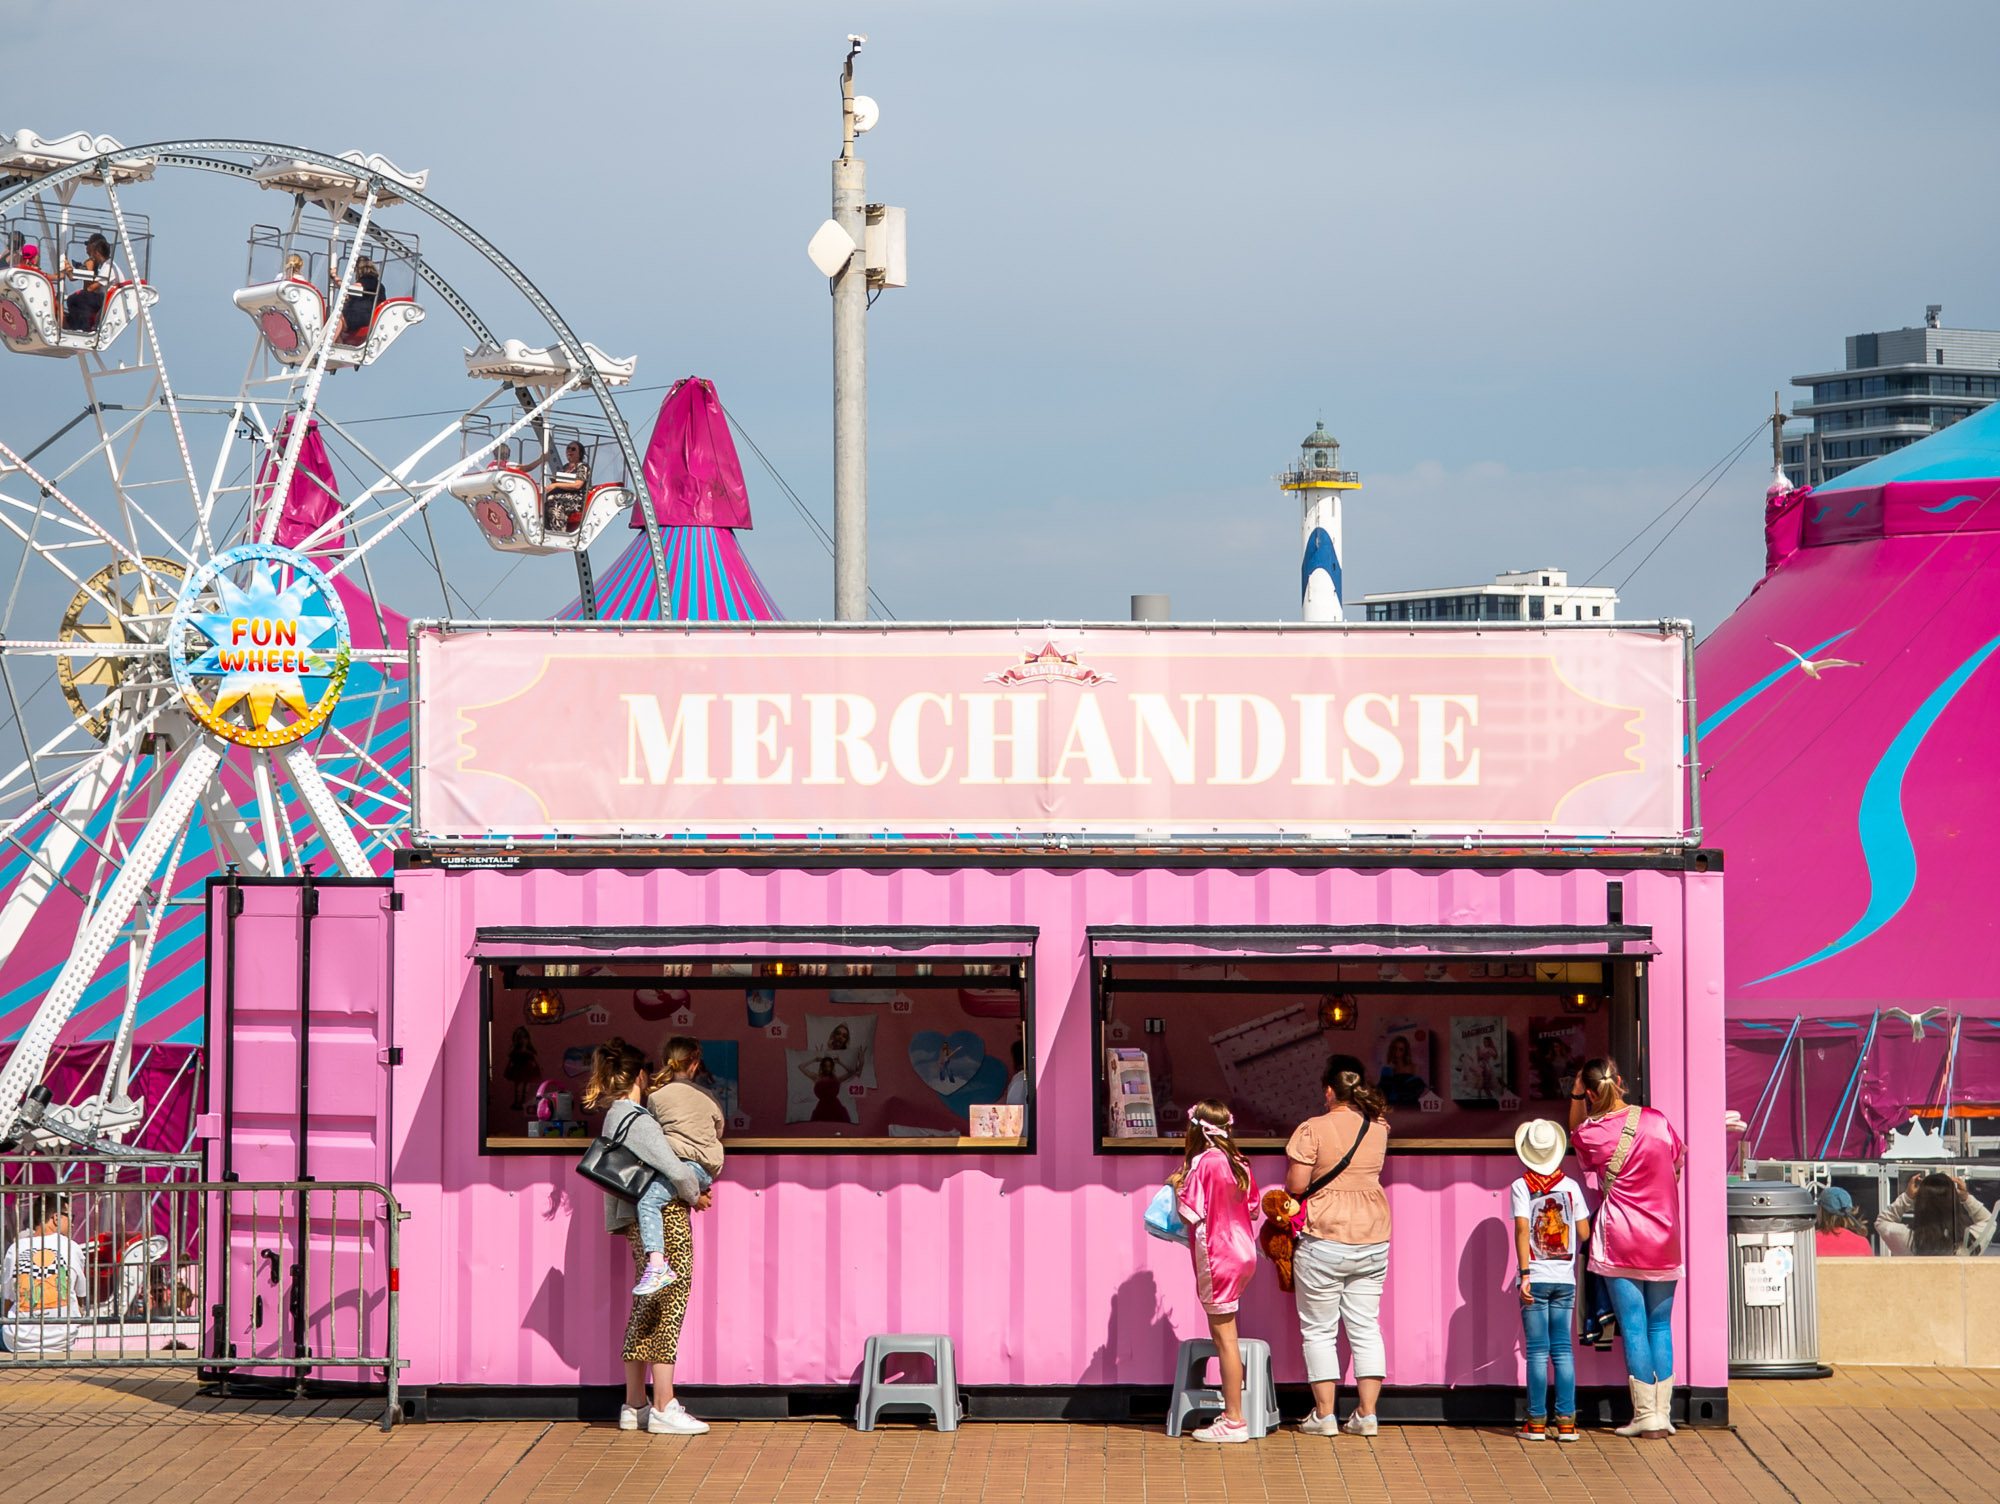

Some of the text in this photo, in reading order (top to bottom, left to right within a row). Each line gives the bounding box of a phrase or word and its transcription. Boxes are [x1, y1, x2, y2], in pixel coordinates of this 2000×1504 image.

[230, 617, 299, 647] FUN
[218, 649, 311, 673] WHEEL
[1022, 664, 1078, 677] CAMILLE
[618, 691, 1481, 787] MERCHANDISE
[441, 856, 520, 864] CUBE-RENTAL.BE
[893, 1001, 910, 1011] €20
[590, 1013, 606, 1023] €10
[678, 1015, 688, 1024] €5
[771, 1026, 781, 1036] €5
[849, 1085, 864, 1095] €20
[1422, 1100, 1440, 1109] €15
[1501, 1099, 1518, 1109] €15
[734, 1117, 744, 1128] €5
